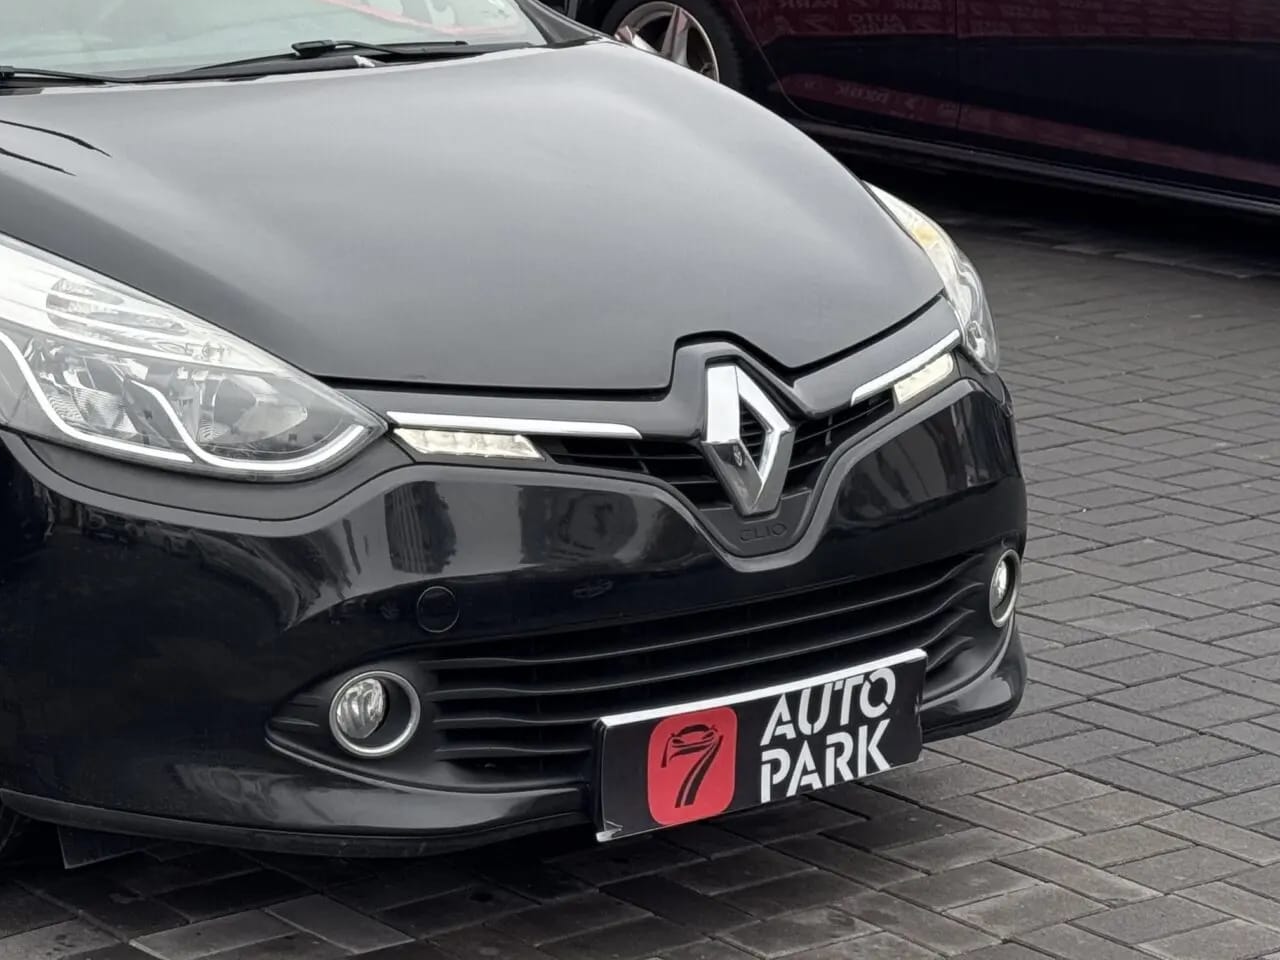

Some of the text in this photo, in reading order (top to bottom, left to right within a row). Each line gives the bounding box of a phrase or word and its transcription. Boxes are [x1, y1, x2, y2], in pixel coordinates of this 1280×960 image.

[739, 523, 788, 542] CLIO
[760, 667, 897, 746] AUTO
[760, 718, 892, 804] PARK
